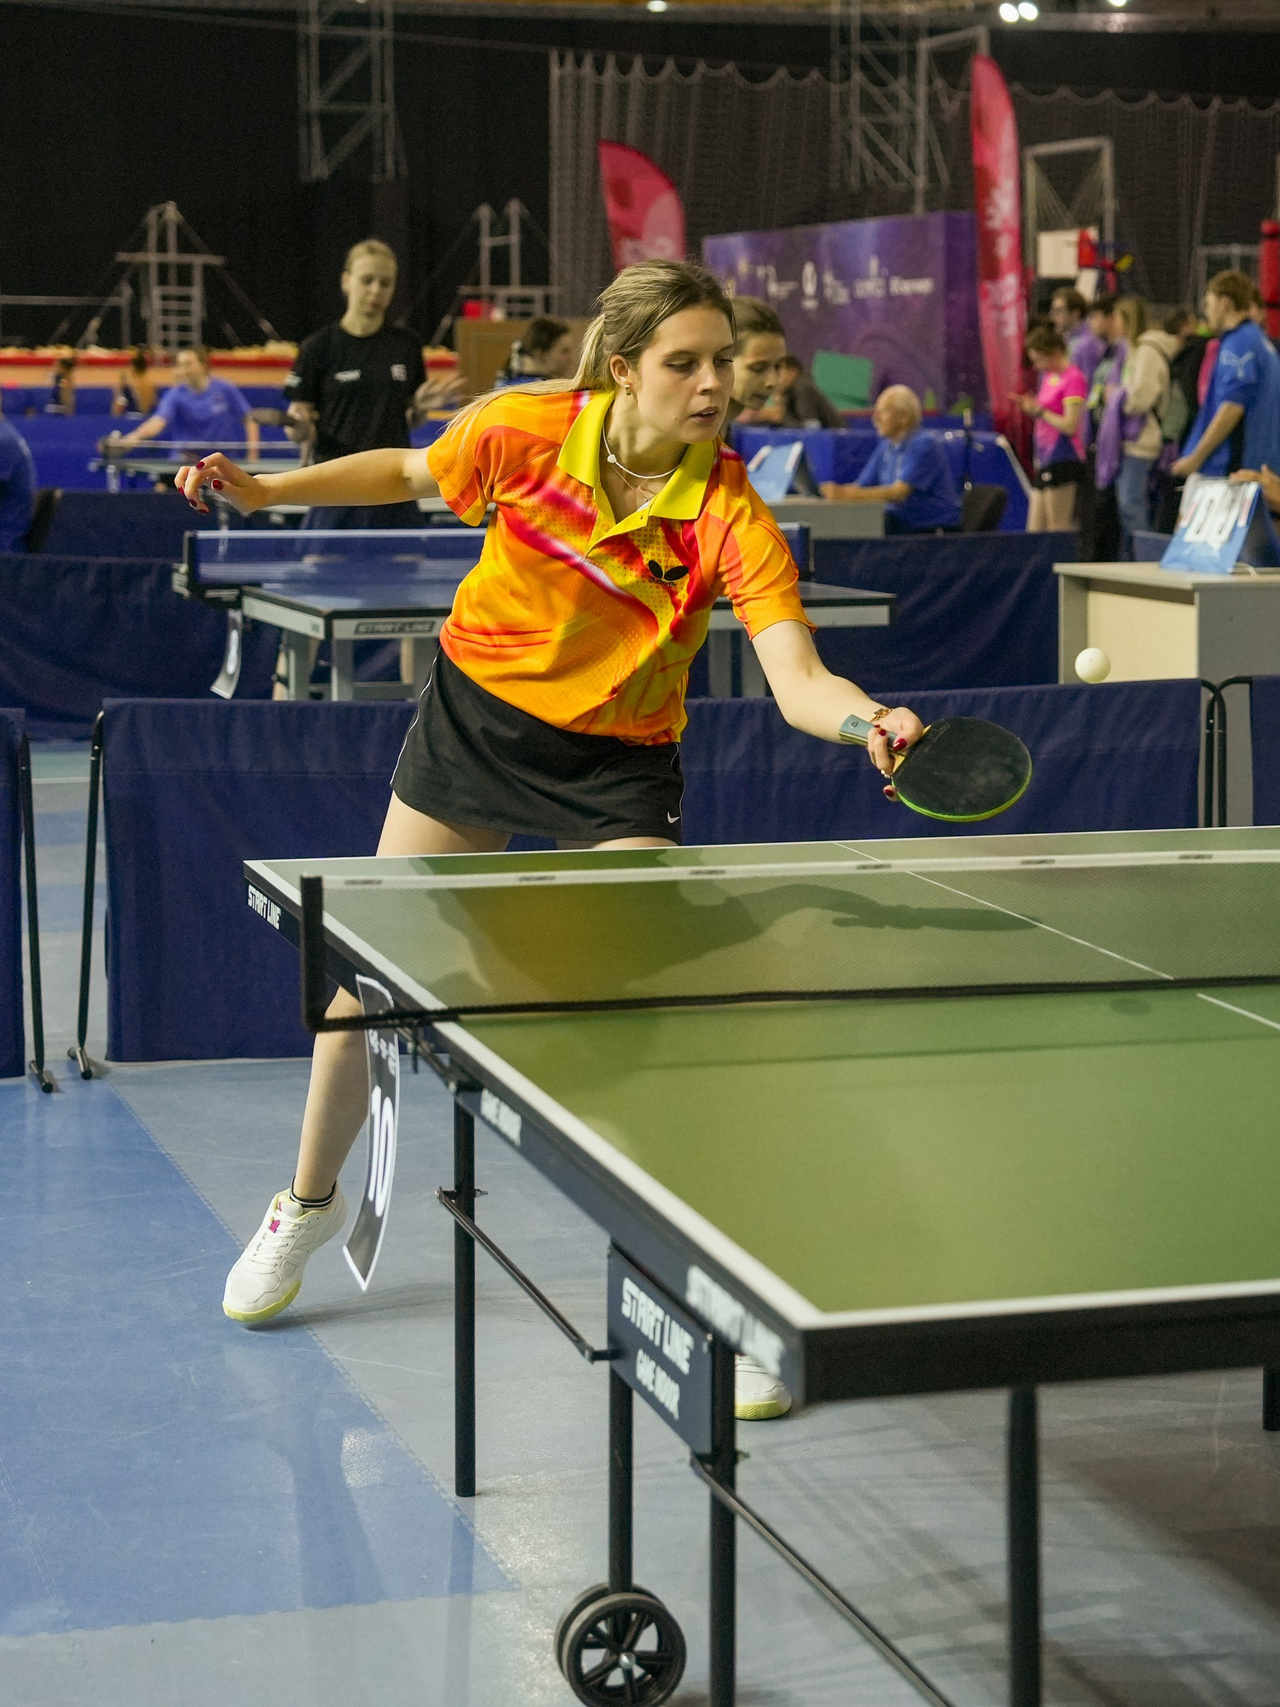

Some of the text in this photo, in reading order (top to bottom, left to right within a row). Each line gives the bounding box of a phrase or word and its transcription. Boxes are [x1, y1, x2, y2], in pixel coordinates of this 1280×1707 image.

[248, 884, 282, 930] START LINE
[368, 1085, 395, 1217] 10
[621, 1277, 694, 1376] START LINE
